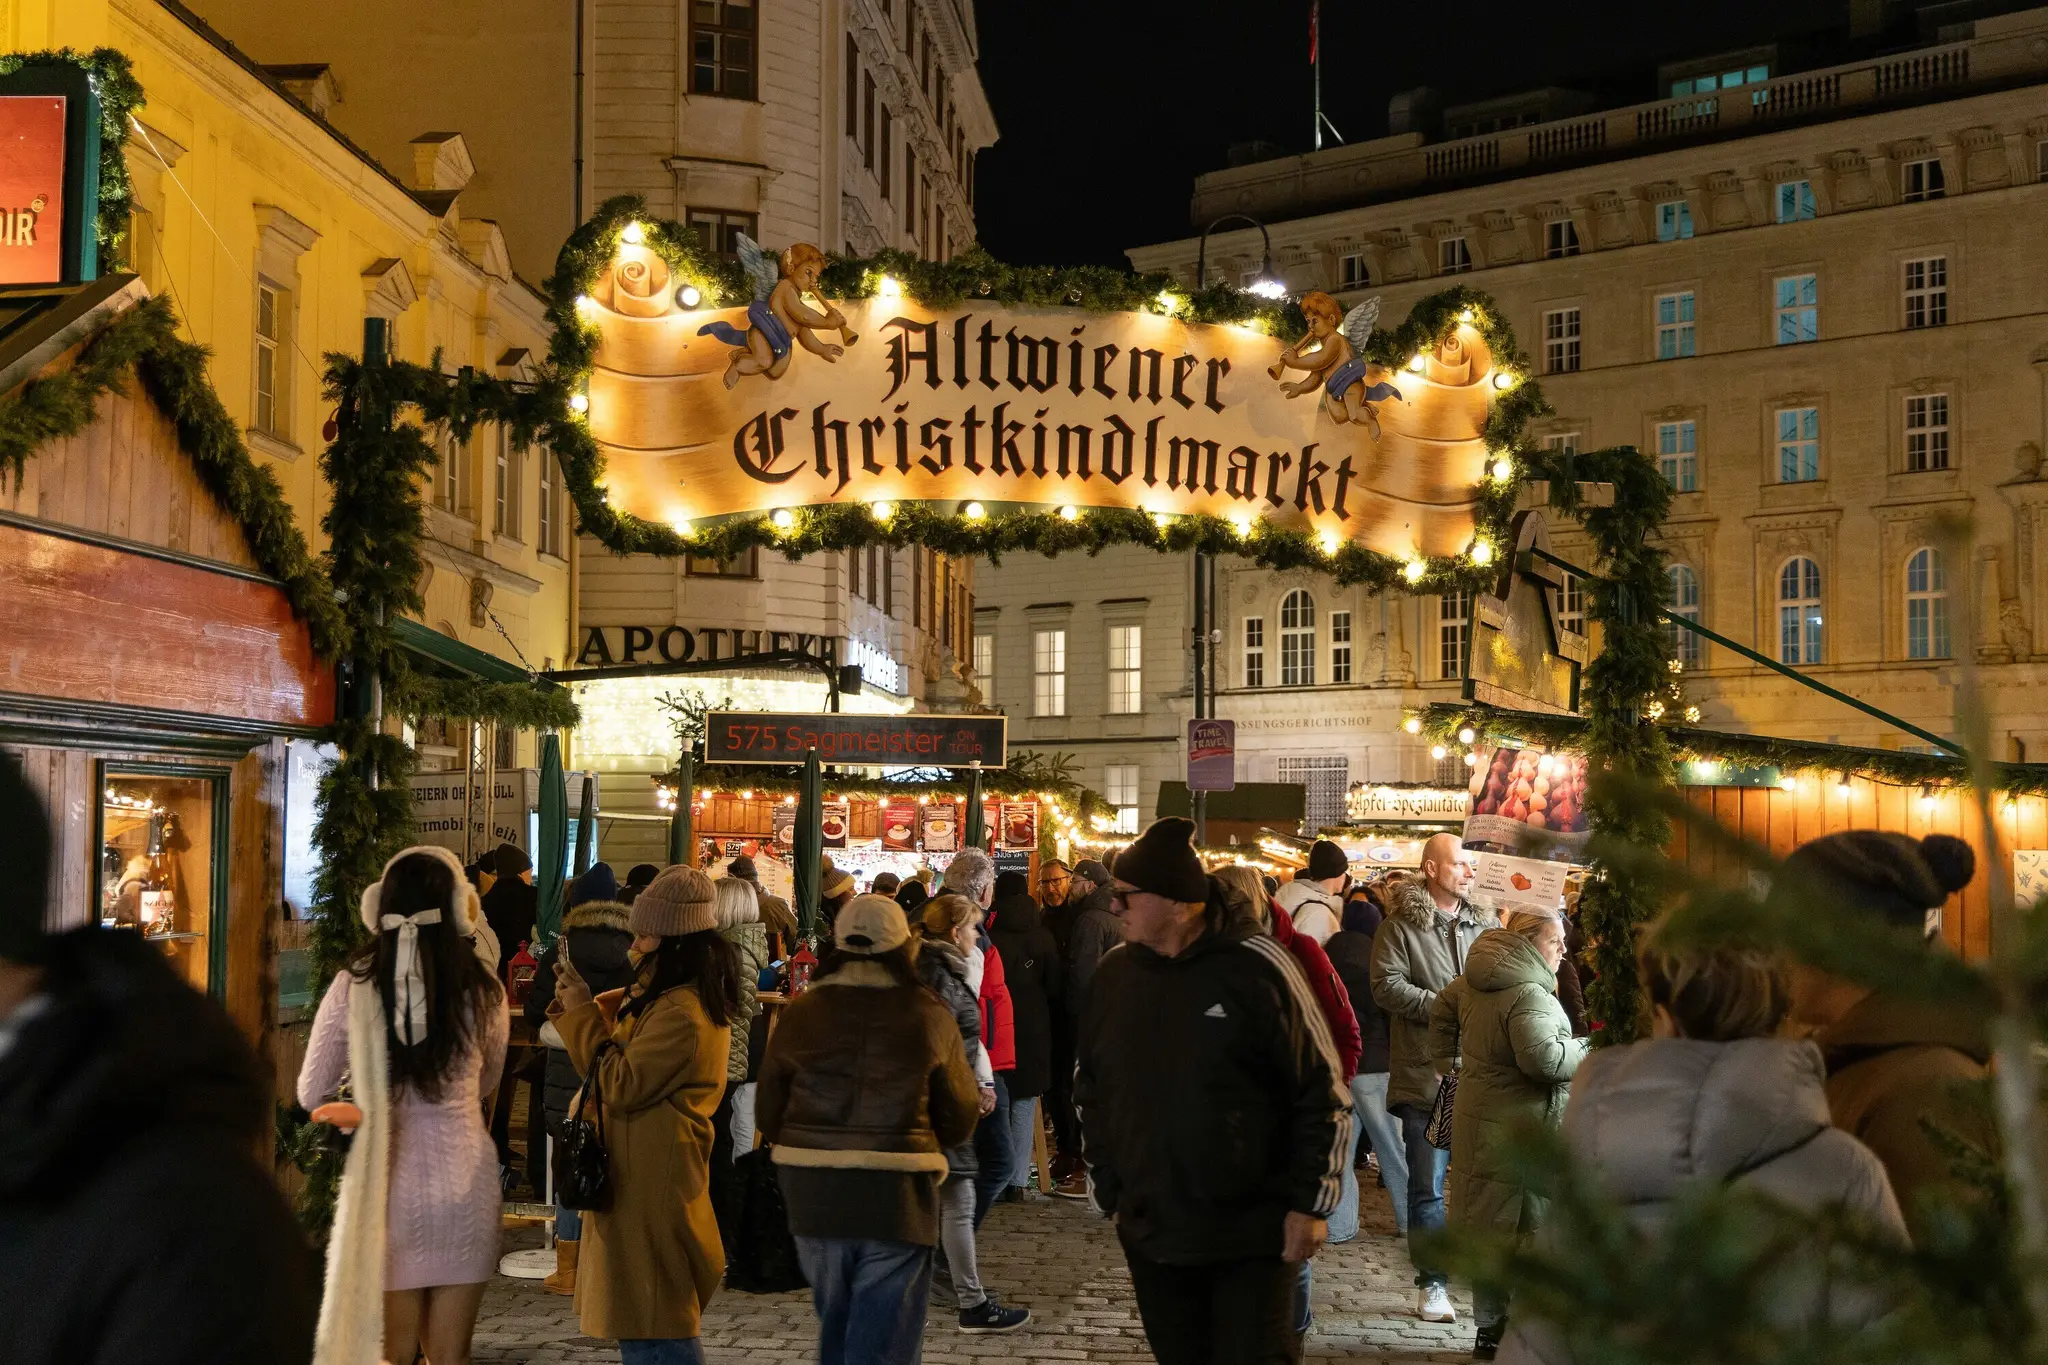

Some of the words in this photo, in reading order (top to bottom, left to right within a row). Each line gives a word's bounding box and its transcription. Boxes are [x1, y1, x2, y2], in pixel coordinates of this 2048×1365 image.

[879, 313, 1232, 415] Altwiener
[733, 401, 1359, 521] Christkindlmarkt
[727, 725, 777, 750] 575
[787, 726, 943, 757] Sagmeister
[957, 730, 975, 741] ON
[949, 743, 983, 755] TOUR
[452, 786, 480, 800] OHE
